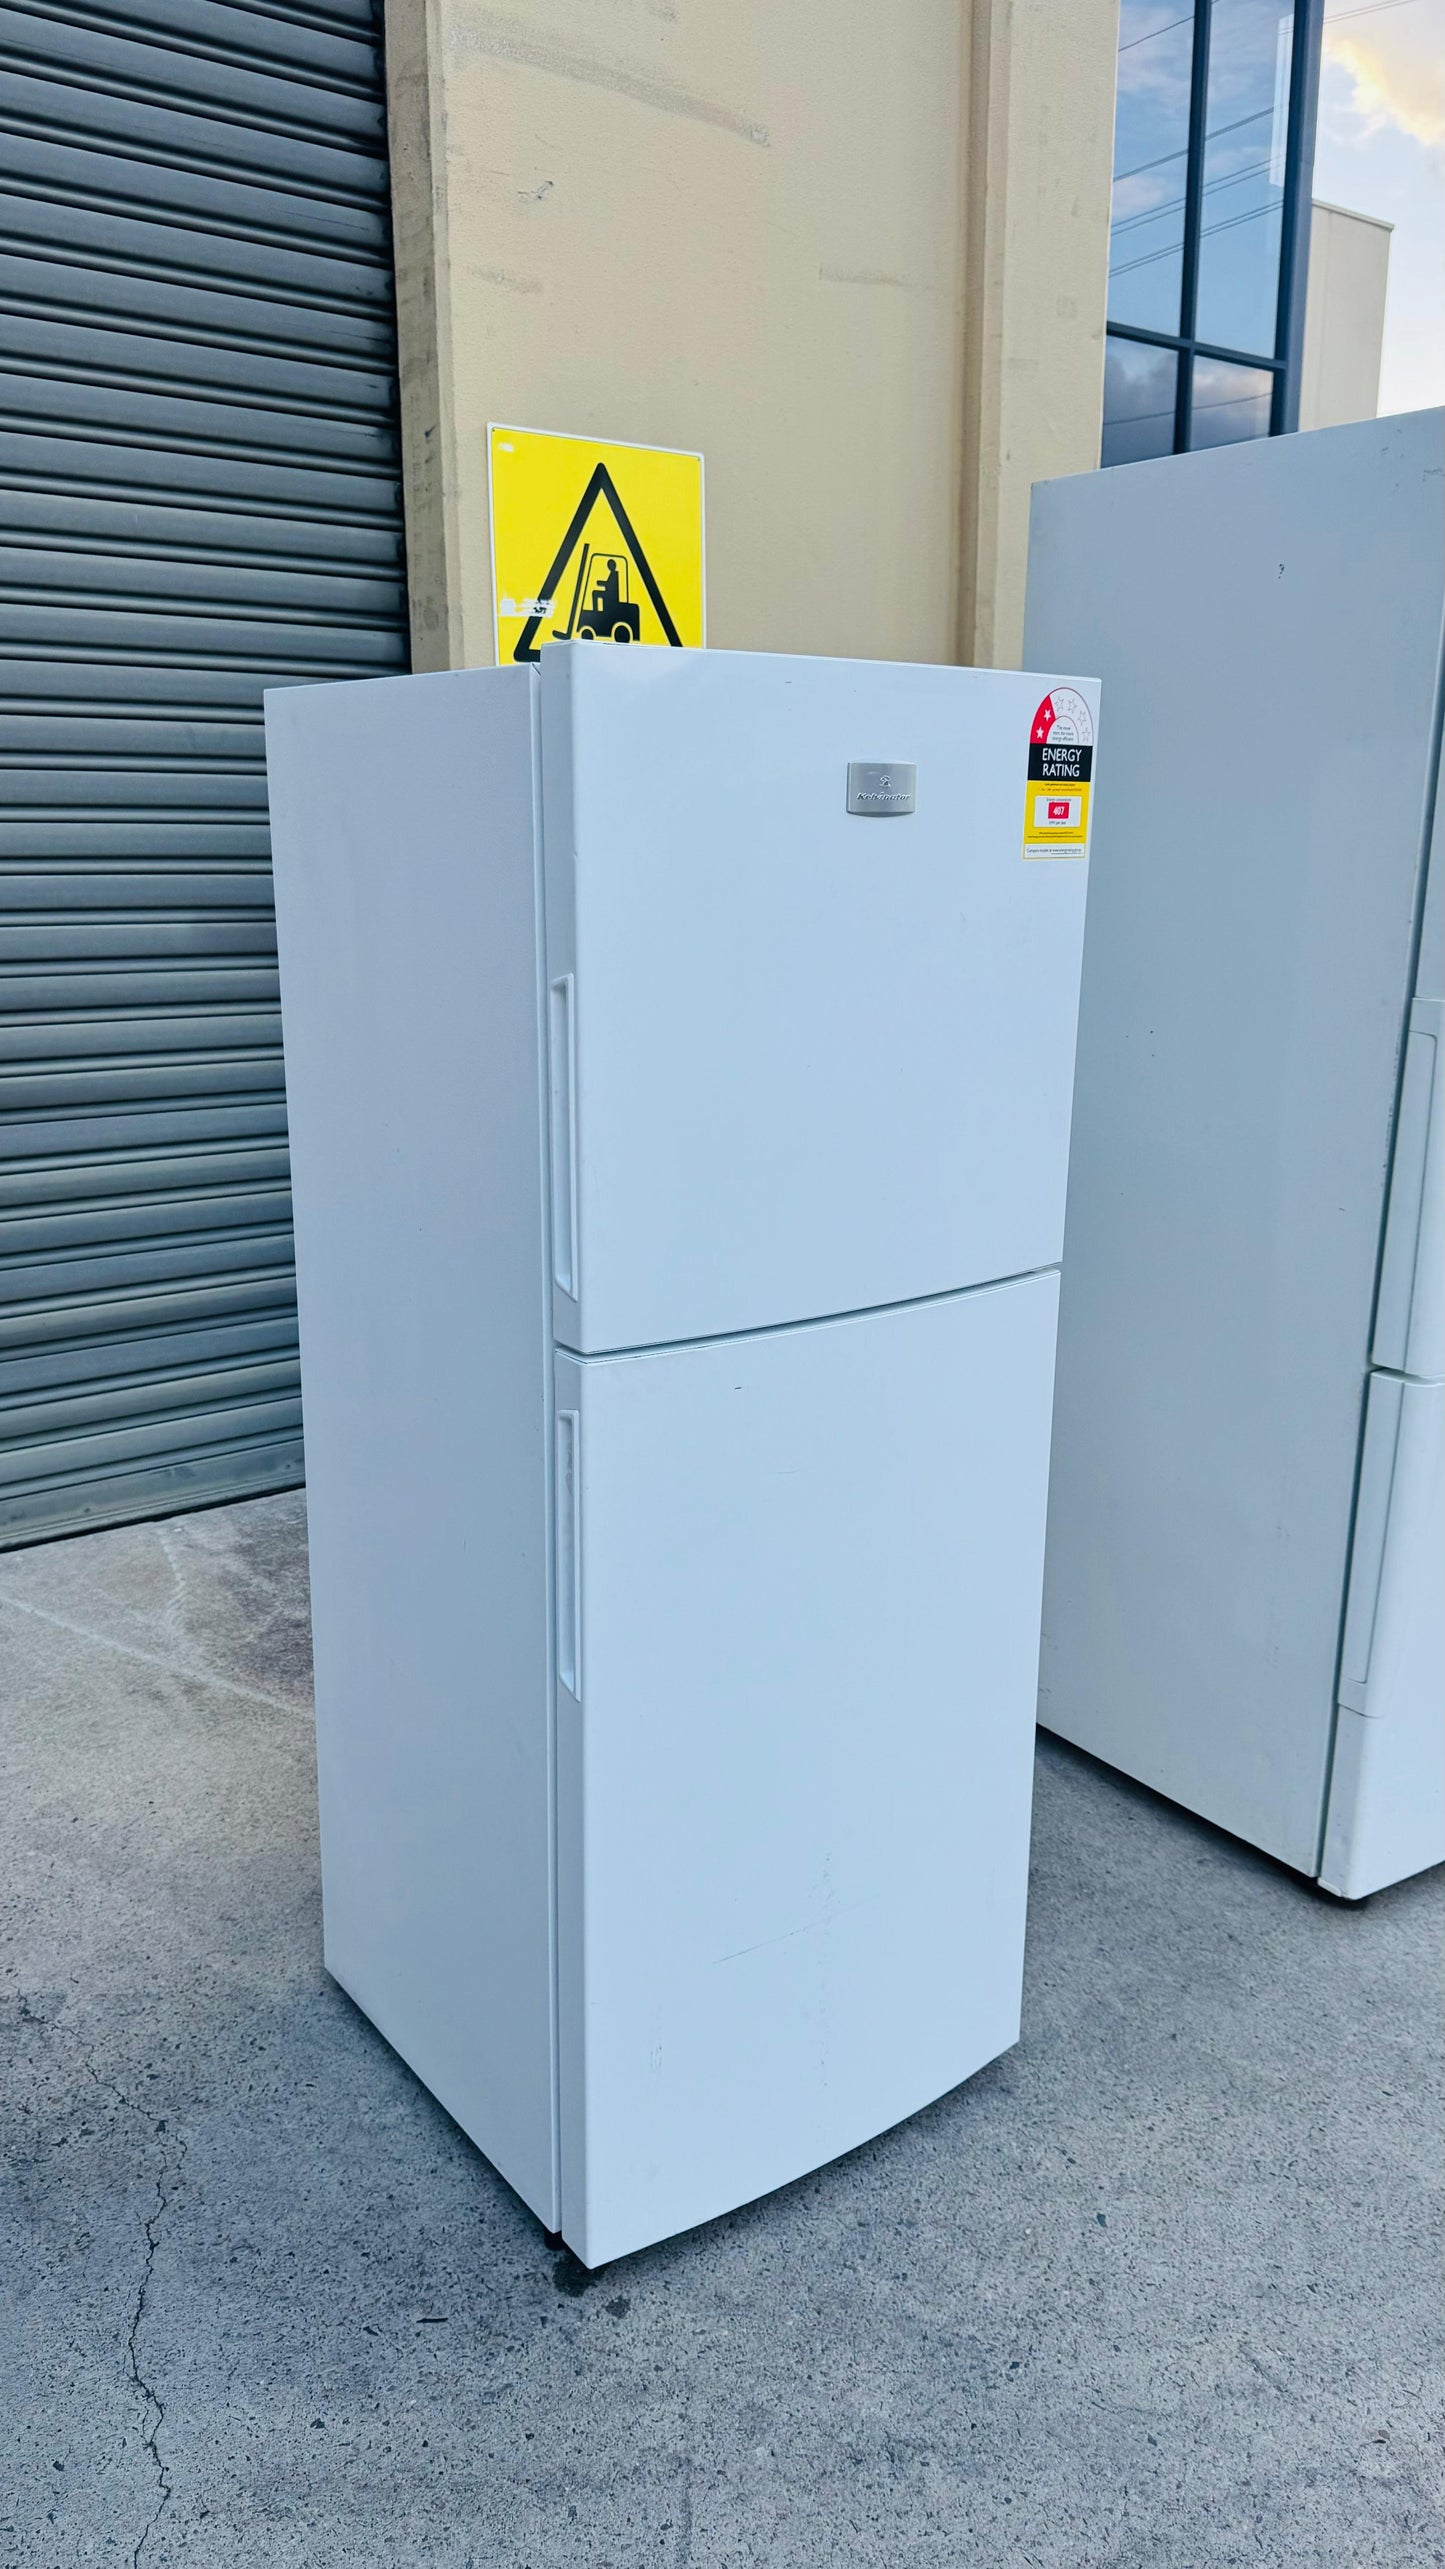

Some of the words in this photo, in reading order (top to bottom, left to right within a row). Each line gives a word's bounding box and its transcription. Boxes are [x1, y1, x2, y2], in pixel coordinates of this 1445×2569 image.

[1042, 748, 1082, 762] ENERGY
[1042, 763, 1080, 777] RATING
[857, 791, 911, 801] Kelvinator
[1052, 806, 1065, 816] 407
